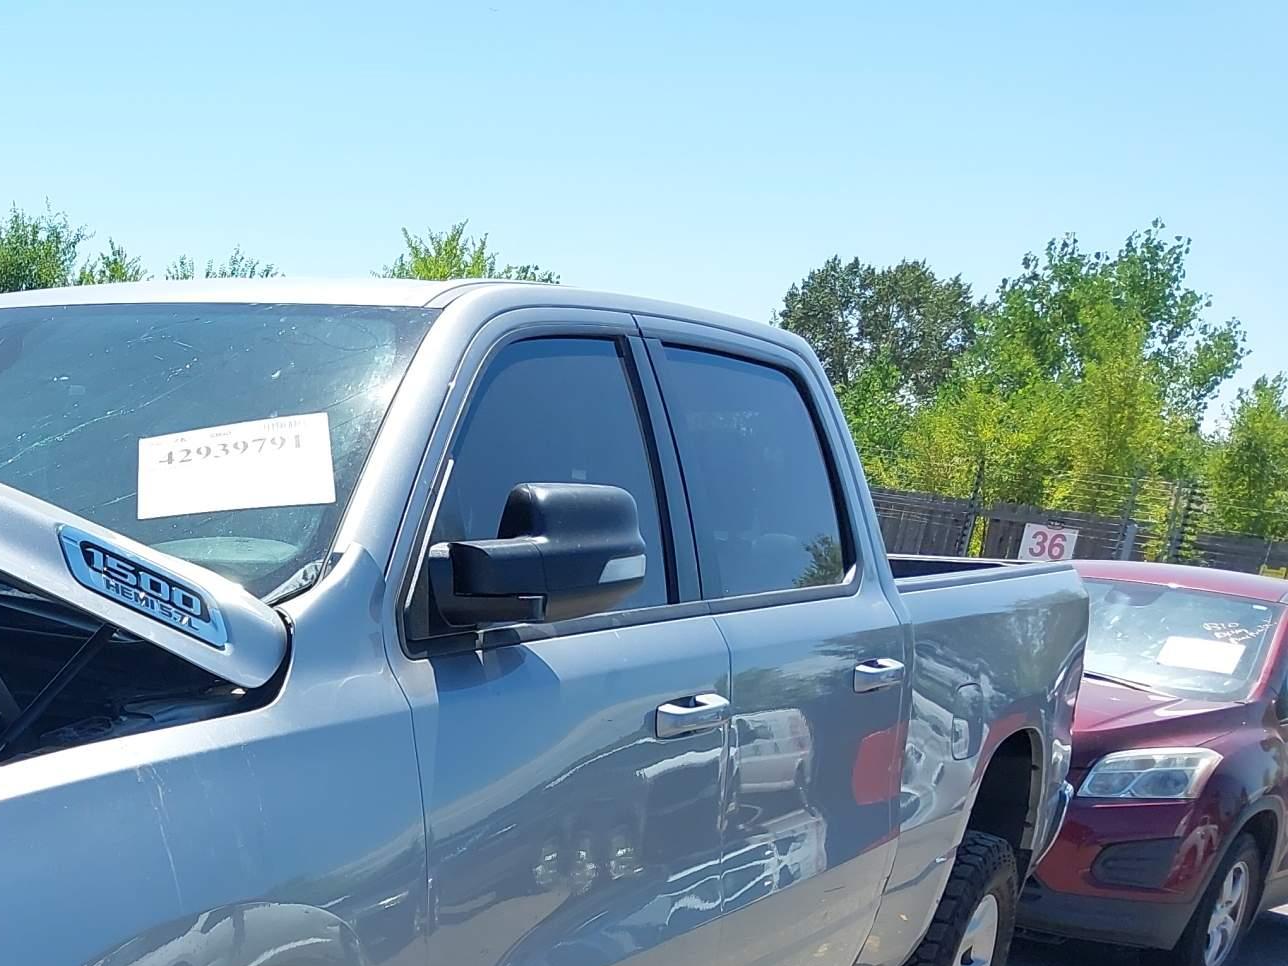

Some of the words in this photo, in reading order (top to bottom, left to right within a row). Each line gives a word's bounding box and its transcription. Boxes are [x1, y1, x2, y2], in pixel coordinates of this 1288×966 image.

[158, 433, 301, 465] 42939791
[1029, 530, 1067, 560] 36
[85, 547, 201, 616] 1500
[102, 575, 155, 609] HEMI
